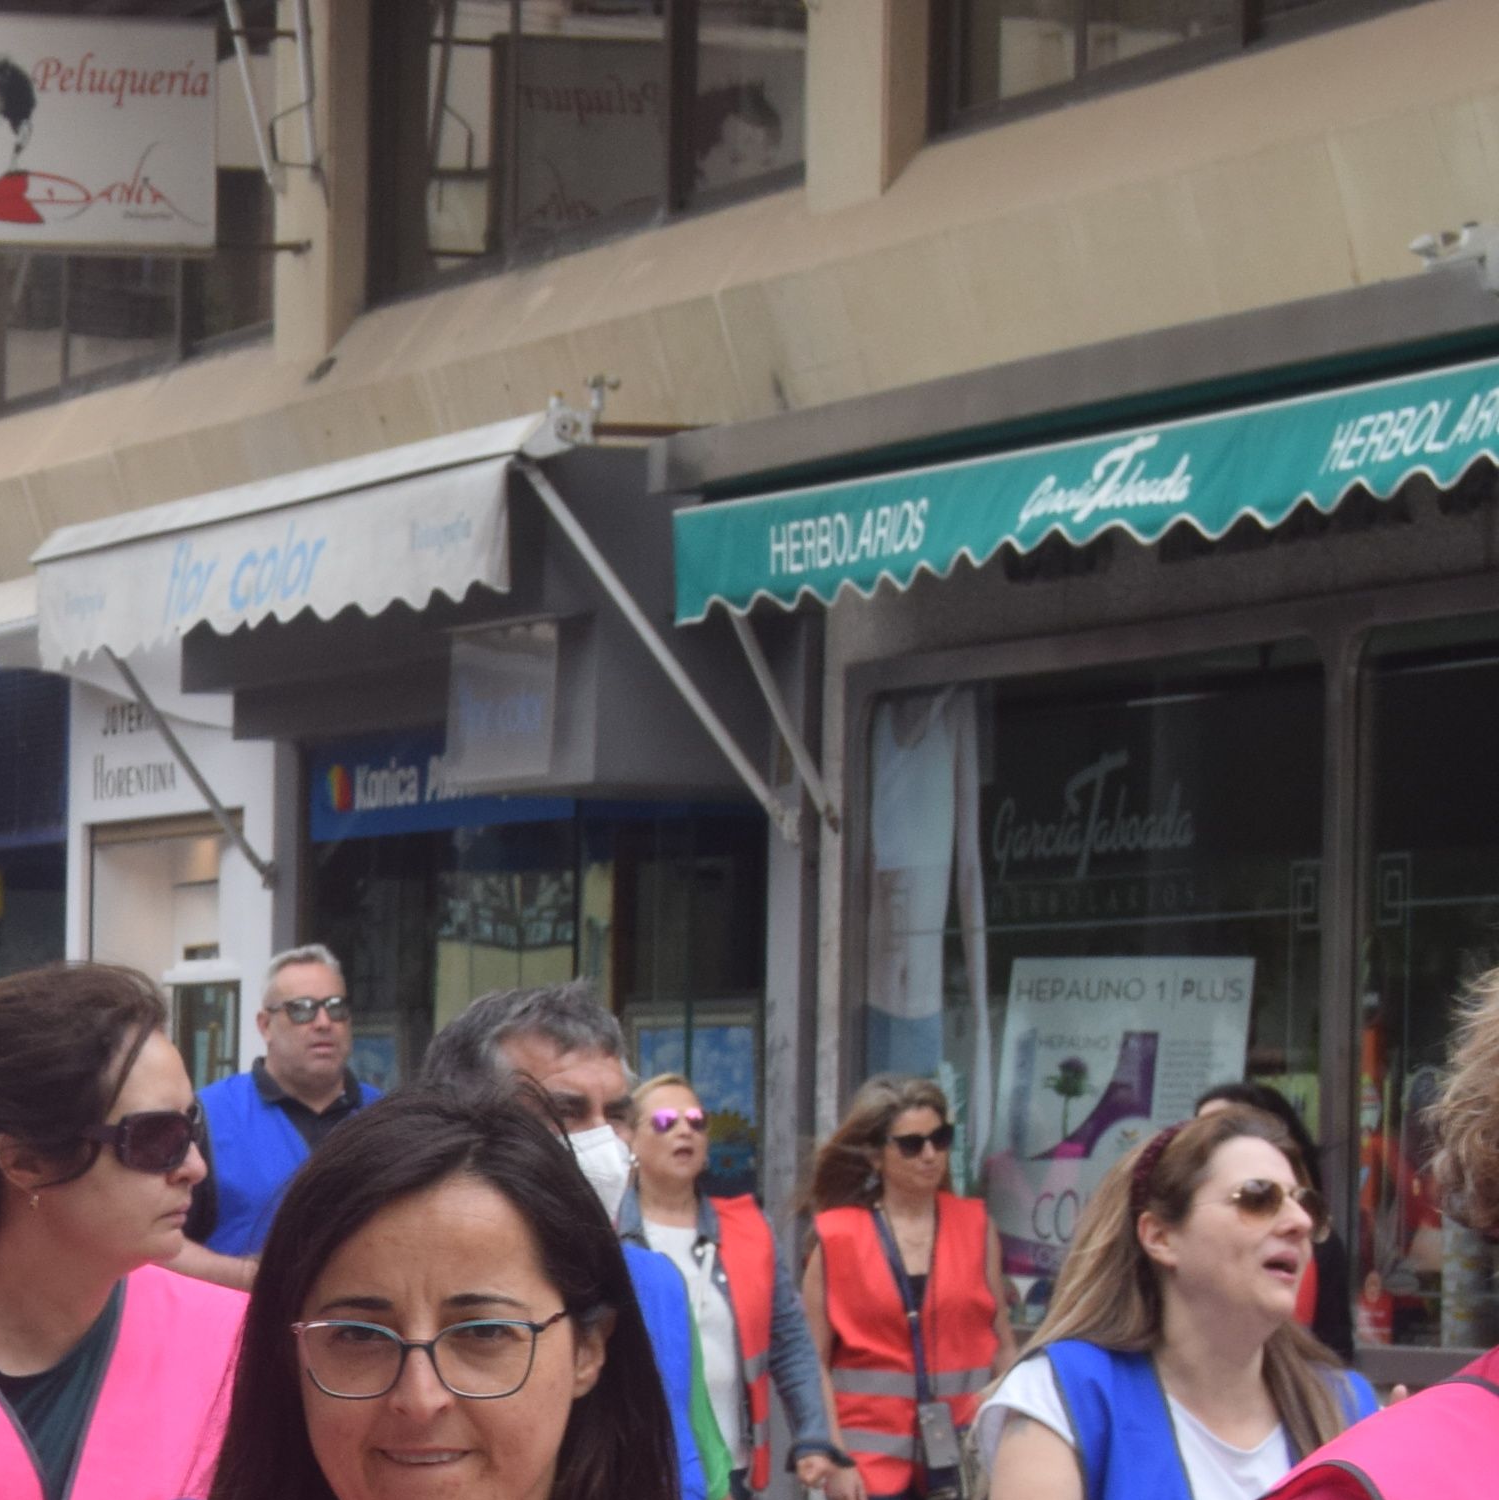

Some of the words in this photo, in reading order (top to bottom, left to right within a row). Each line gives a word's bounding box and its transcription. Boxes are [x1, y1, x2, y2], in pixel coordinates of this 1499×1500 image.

[32, 53, 211, 110] Peluquería
[769, 497, 928, 576] HERBOLARIOS
[229, 520, 326, 612] color
[353, 757, 419, 812] Konica
[1016, 978, 1146, 1001] HEPAUNO
[1156, 981, 1166, 999] 1
[1183, 978, 1244, 1000] PLUS
